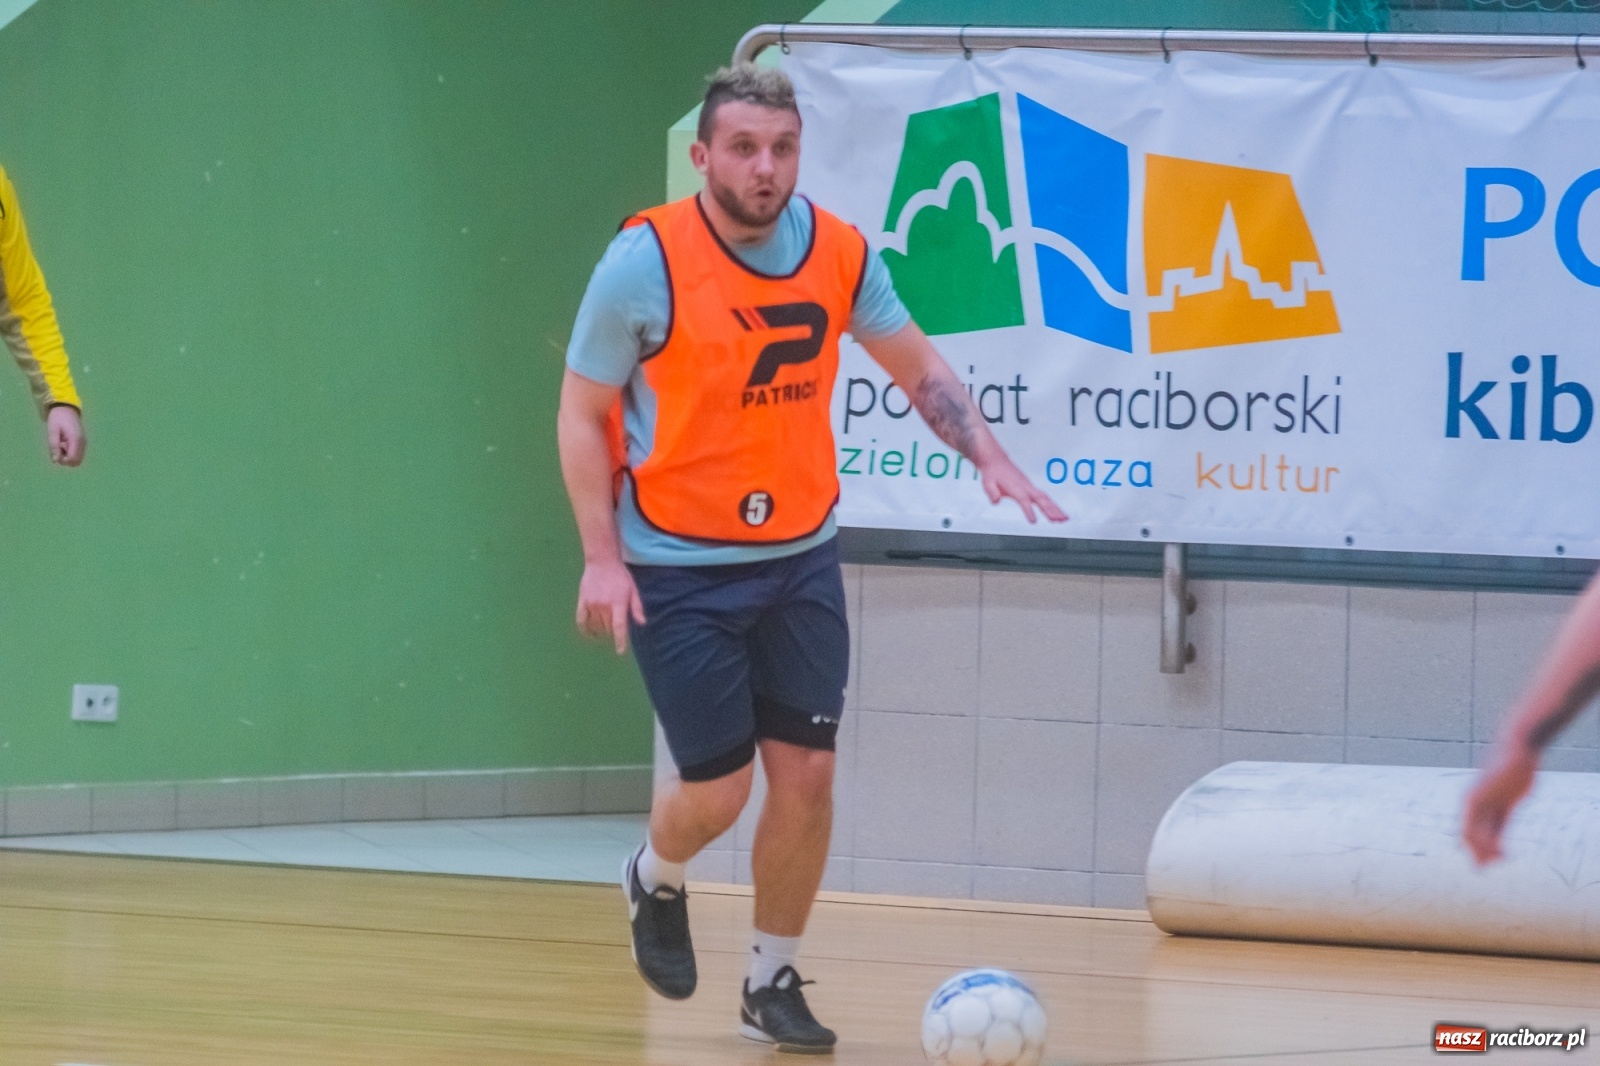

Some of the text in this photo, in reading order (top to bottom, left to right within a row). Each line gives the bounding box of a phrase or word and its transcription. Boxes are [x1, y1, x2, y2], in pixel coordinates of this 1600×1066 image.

[843, 364, 1342, 435] poiat raciborski
[1046, 458, 1154, 488] oaza
[1196, 452, 1341, 493] kultur
[745, 492, 768, 526] 5
